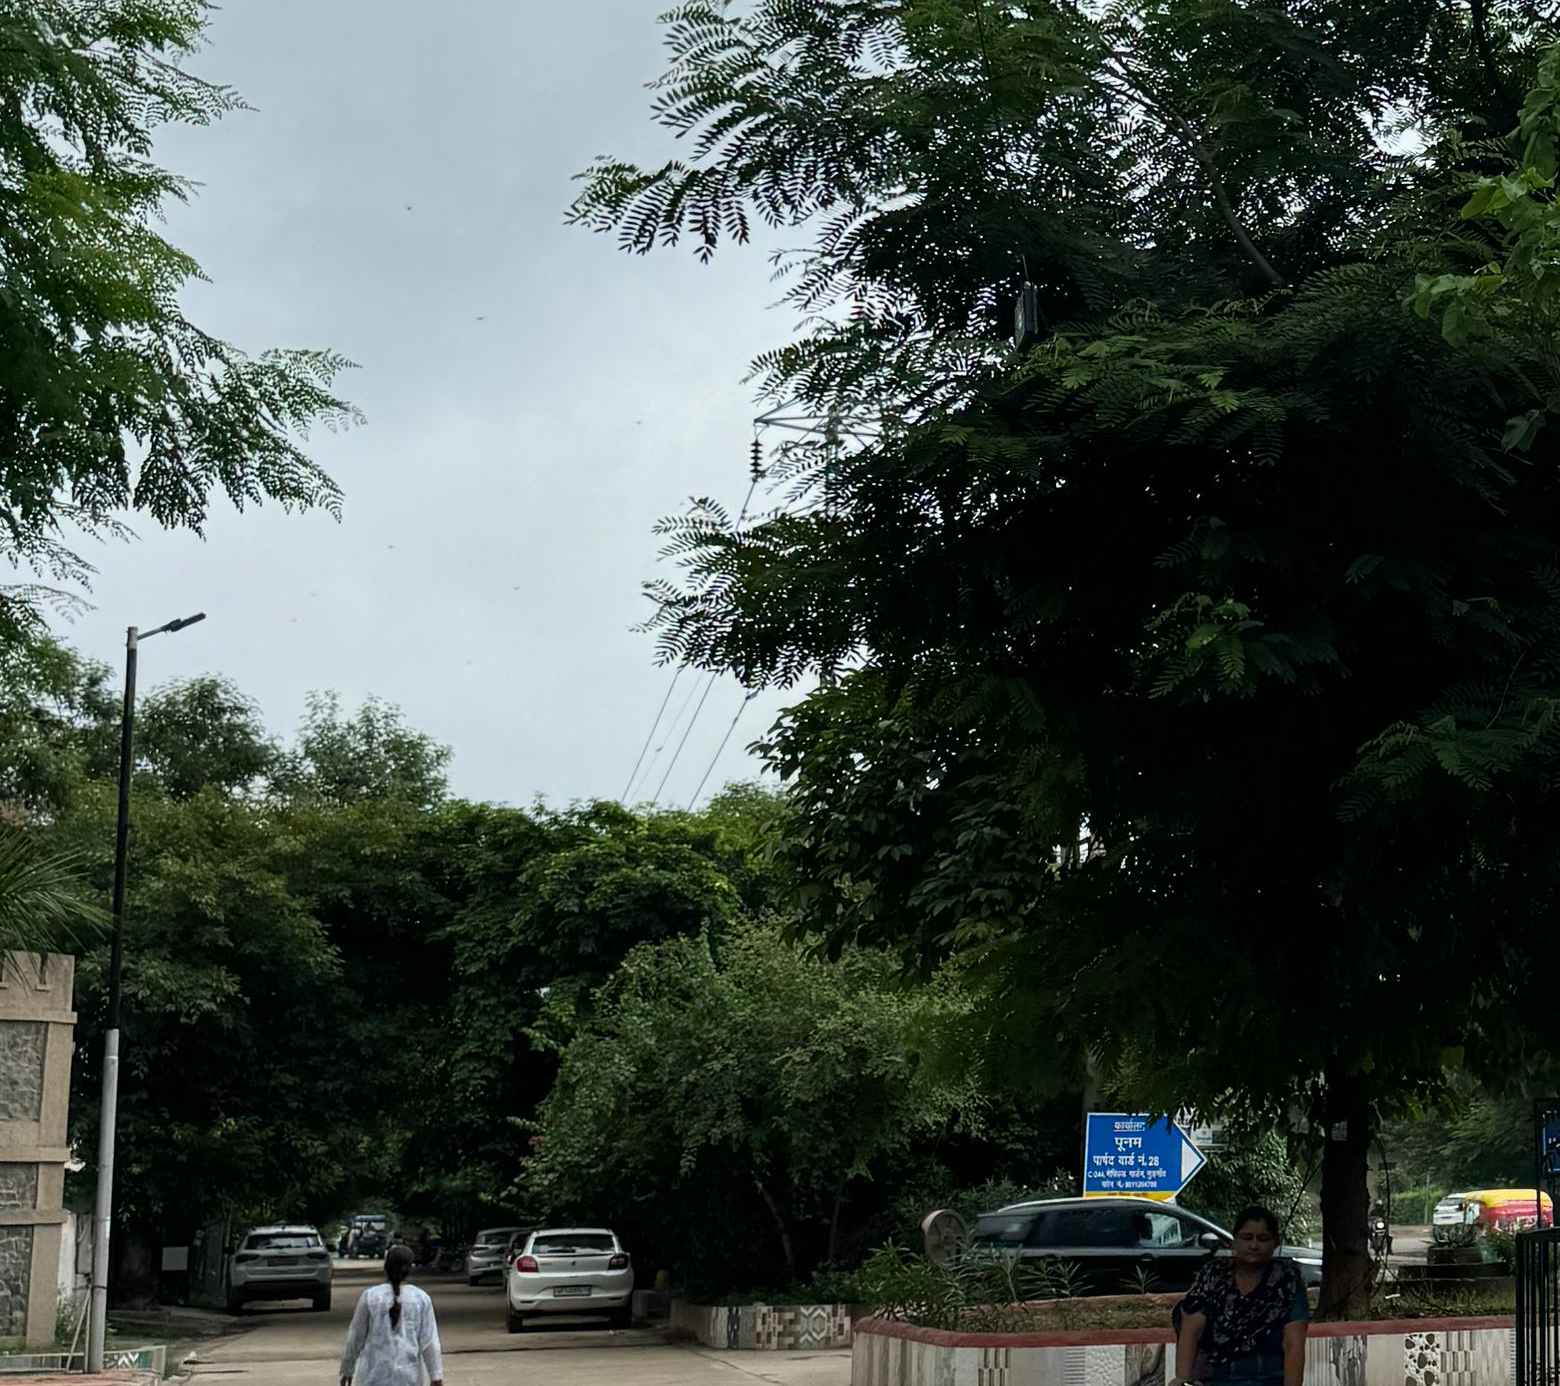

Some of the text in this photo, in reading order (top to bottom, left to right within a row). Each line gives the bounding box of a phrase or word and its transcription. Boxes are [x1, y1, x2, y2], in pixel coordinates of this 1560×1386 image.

[1114, 1137, 1142, 1152] पूनम
[1093, 1152, 1115, 1166] पार्षद
[1118, 1152, 1135, 1166] वार्ड
